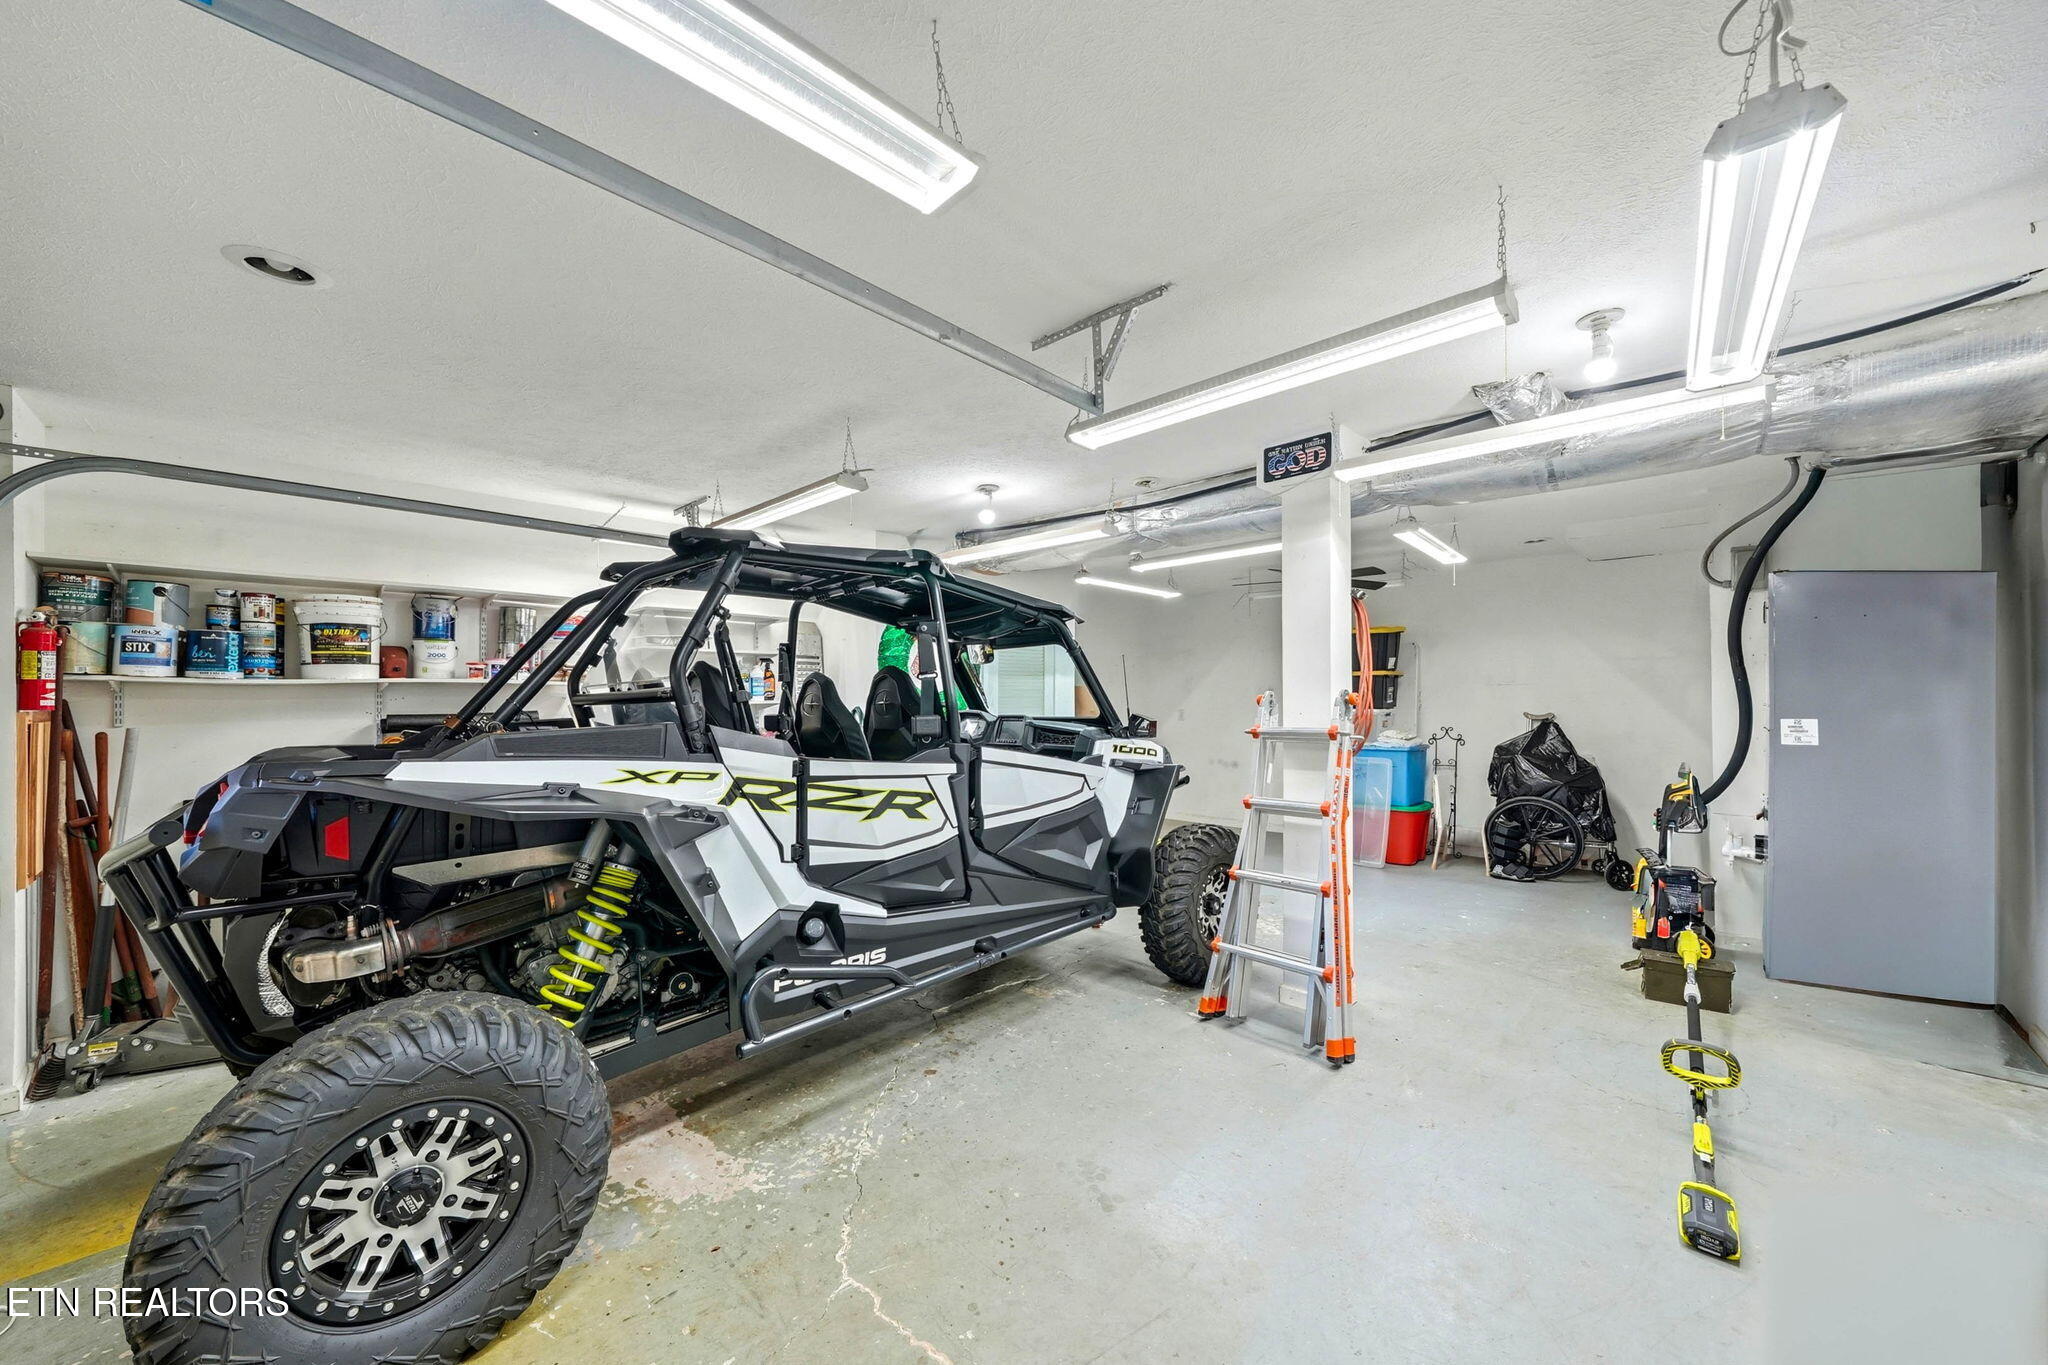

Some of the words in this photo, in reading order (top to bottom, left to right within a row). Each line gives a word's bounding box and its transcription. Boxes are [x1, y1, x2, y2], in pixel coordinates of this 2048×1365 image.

[1268, 446, 1327, 476] GOD
[125, 641, 151, 652] STIX
[1112, 744, 1157, 757] 1000
[600, 768, 721, 784] XP
[718, 776, 937, 822] RZR
[403, 1194, 419, 1215] TUSK
